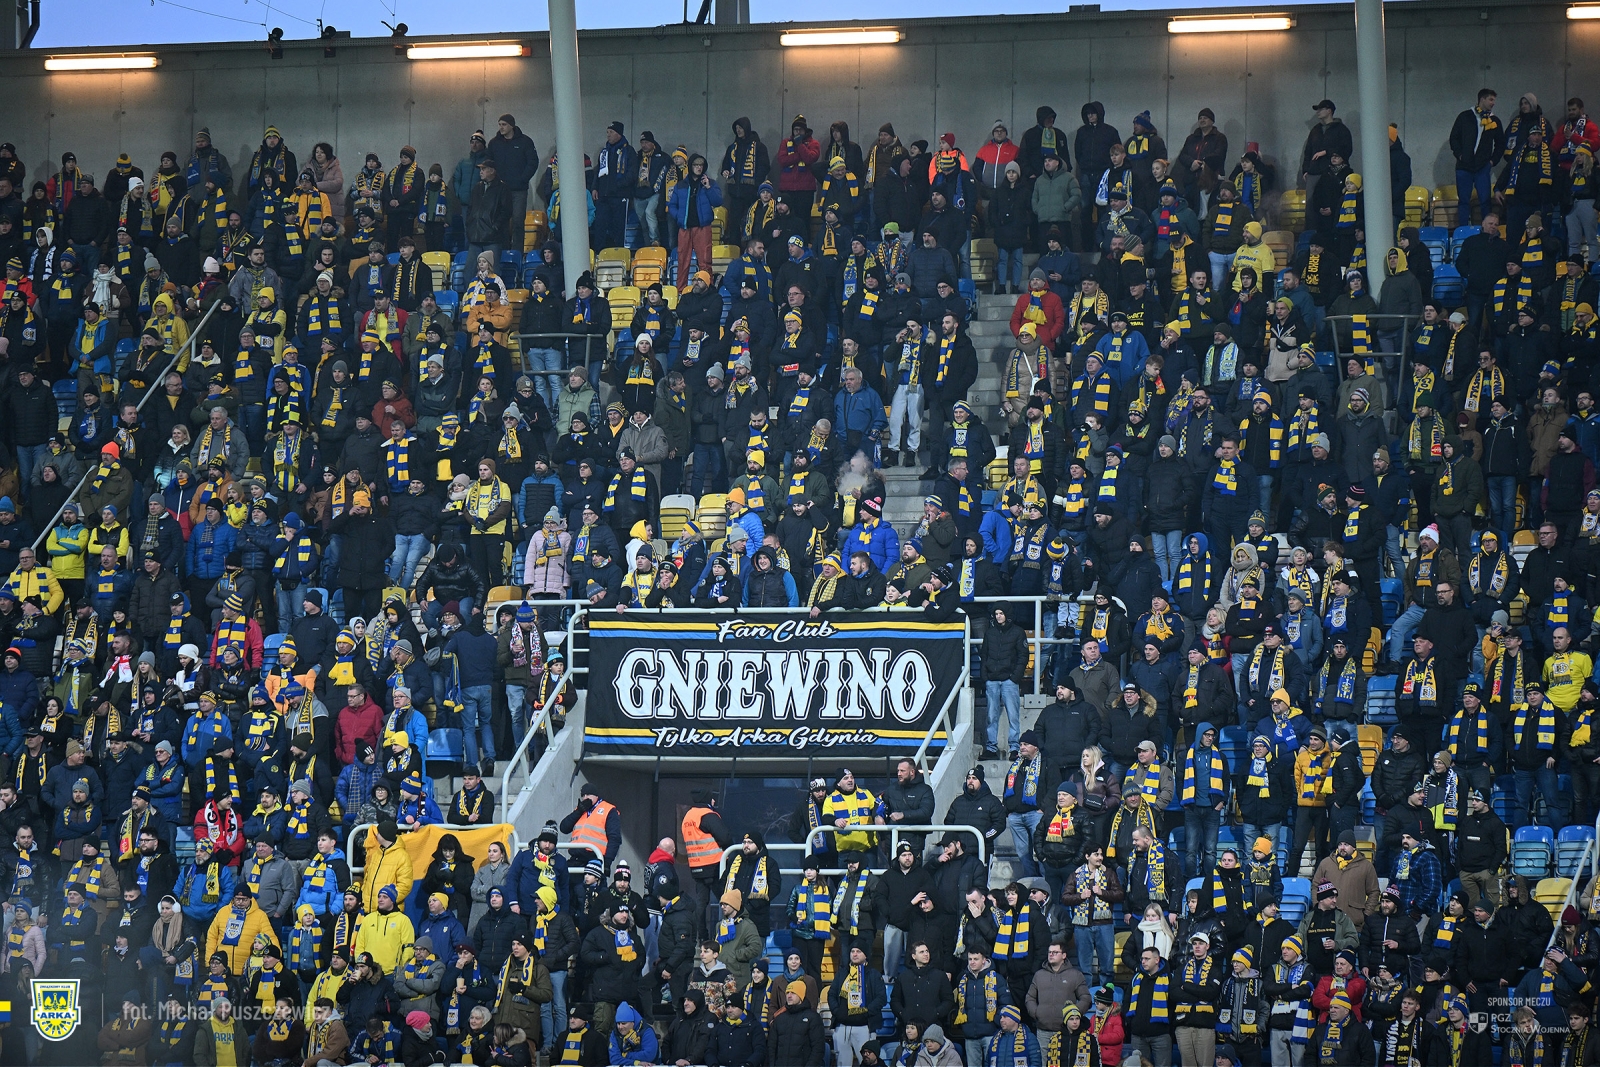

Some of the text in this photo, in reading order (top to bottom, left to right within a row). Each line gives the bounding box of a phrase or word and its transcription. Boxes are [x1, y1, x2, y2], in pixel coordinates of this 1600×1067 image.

[718, 619, 836, 643] Fan Club
[613, 648, 935, 723] GNIEWINO
[651, 726, 878, 749] Tylko Arka Gdynia
